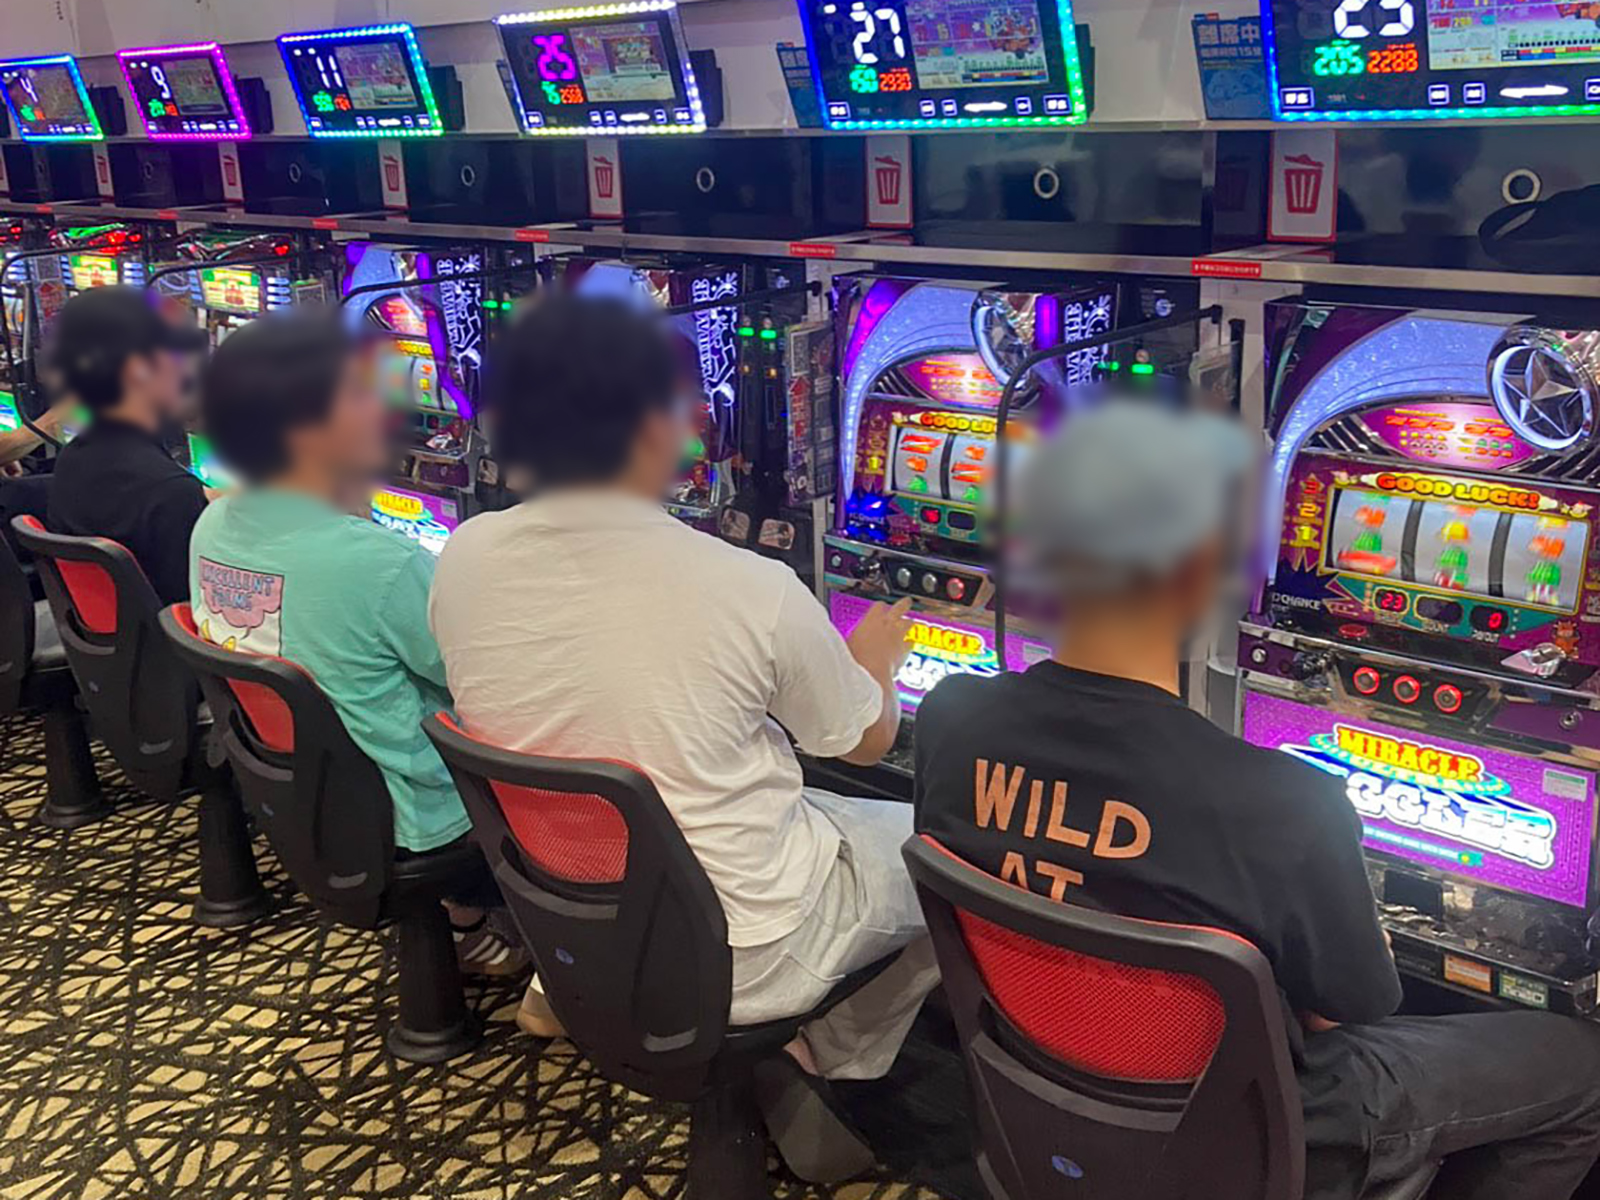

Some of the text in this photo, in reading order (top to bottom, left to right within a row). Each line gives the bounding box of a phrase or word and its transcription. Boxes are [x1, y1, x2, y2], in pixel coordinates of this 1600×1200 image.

[850, 8, 906, 64] 27
[1376, 473, 1540, 509] GOOD LUCK!
[1380, 592, 1403, 611] 23
[1337, 726, 1482, 783] MIRACLE
[974, 757, 1152, 859] WILD
[1000, 850, 1084, 902] AT
